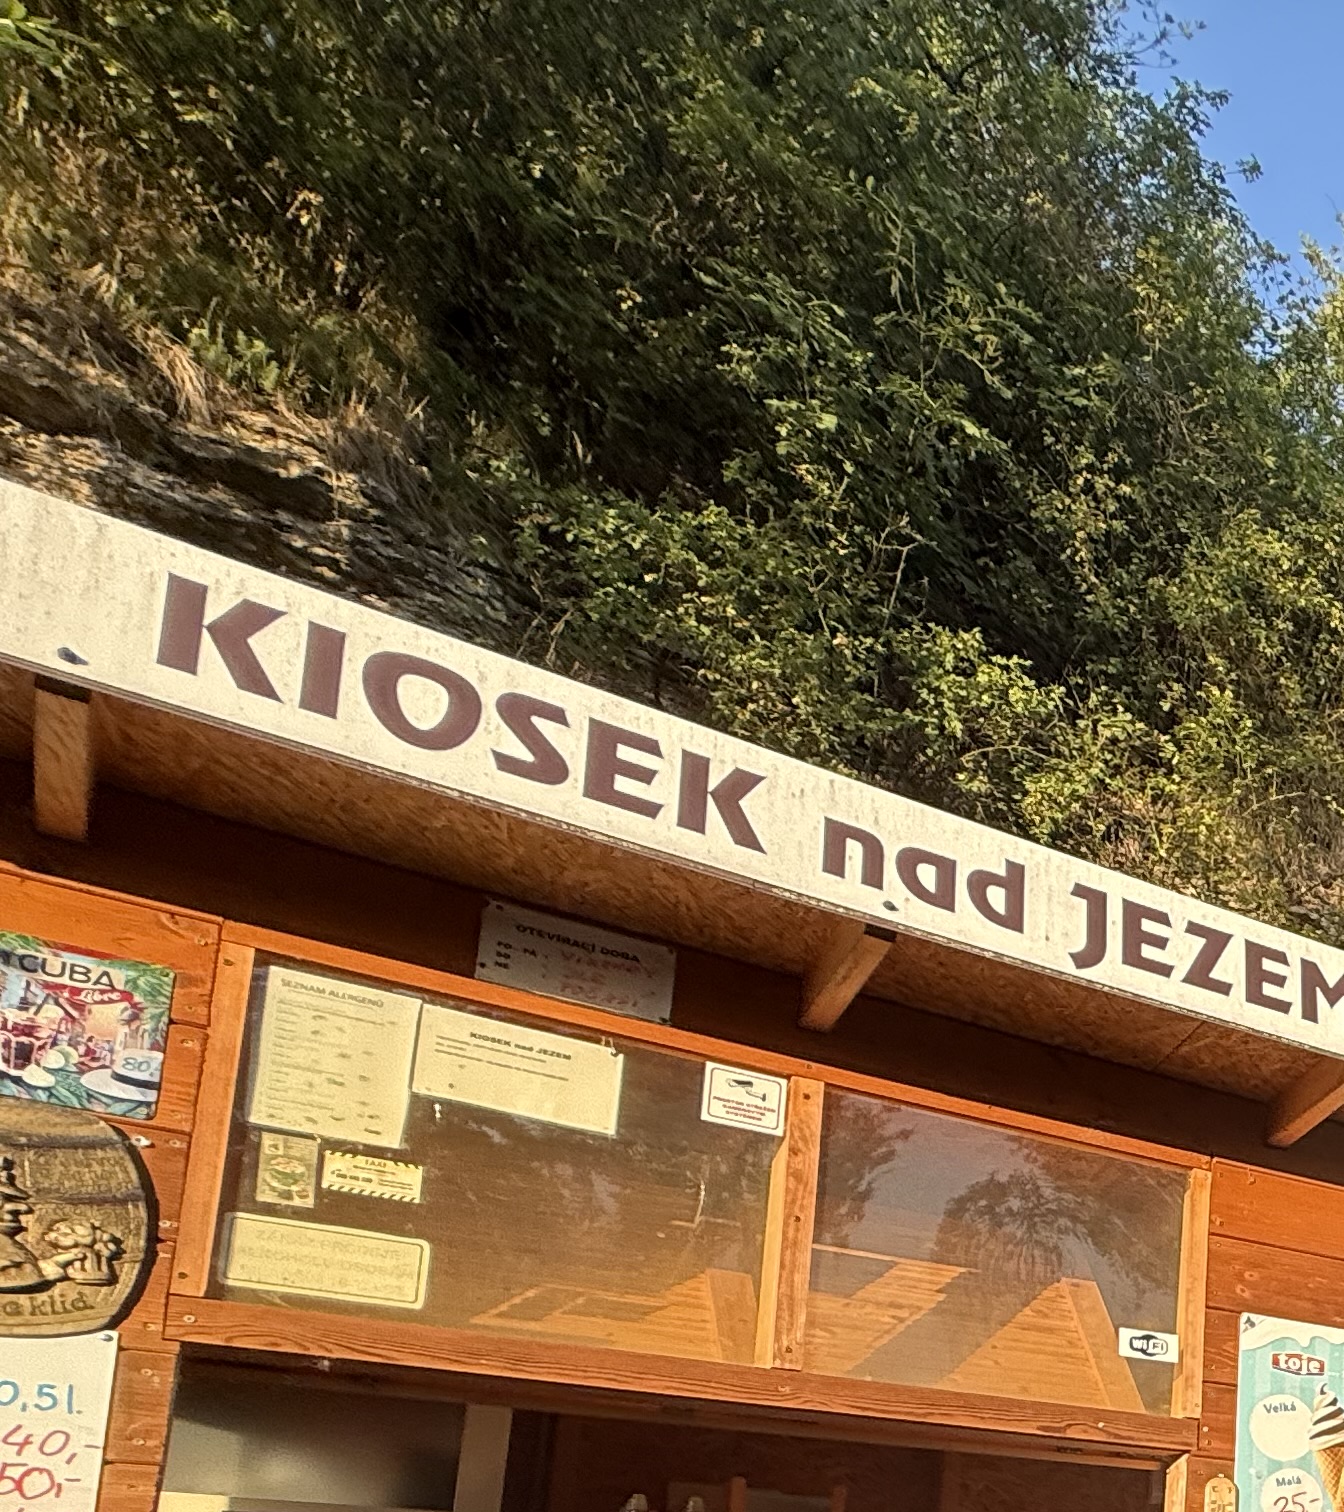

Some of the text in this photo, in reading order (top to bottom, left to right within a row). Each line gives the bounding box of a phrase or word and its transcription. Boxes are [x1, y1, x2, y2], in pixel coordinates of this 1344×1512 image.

[155, 571, 767, 855] KIOSEK
[821, 815, 1026, 934] nad
[18, 953, 117, 990] CUBA
[280, 978, 327, 996] SEZNAM
[469, 1031, 512, 1048] KIOSEK
[514, 1043, 534, 1053] nad
[535, 1046, 572, 1061] JEZEM
[364, 1158, 388, 1169] TAXI
[1277, 1353, 1321, 1375] toje
[1263, 1401, 1297, 1414] Velká
[1, 1423, 101, 1465] 40,-
[0, 1461, 82, 1501] 50,-
[1275, 1475, 1302, 1488] Malá
